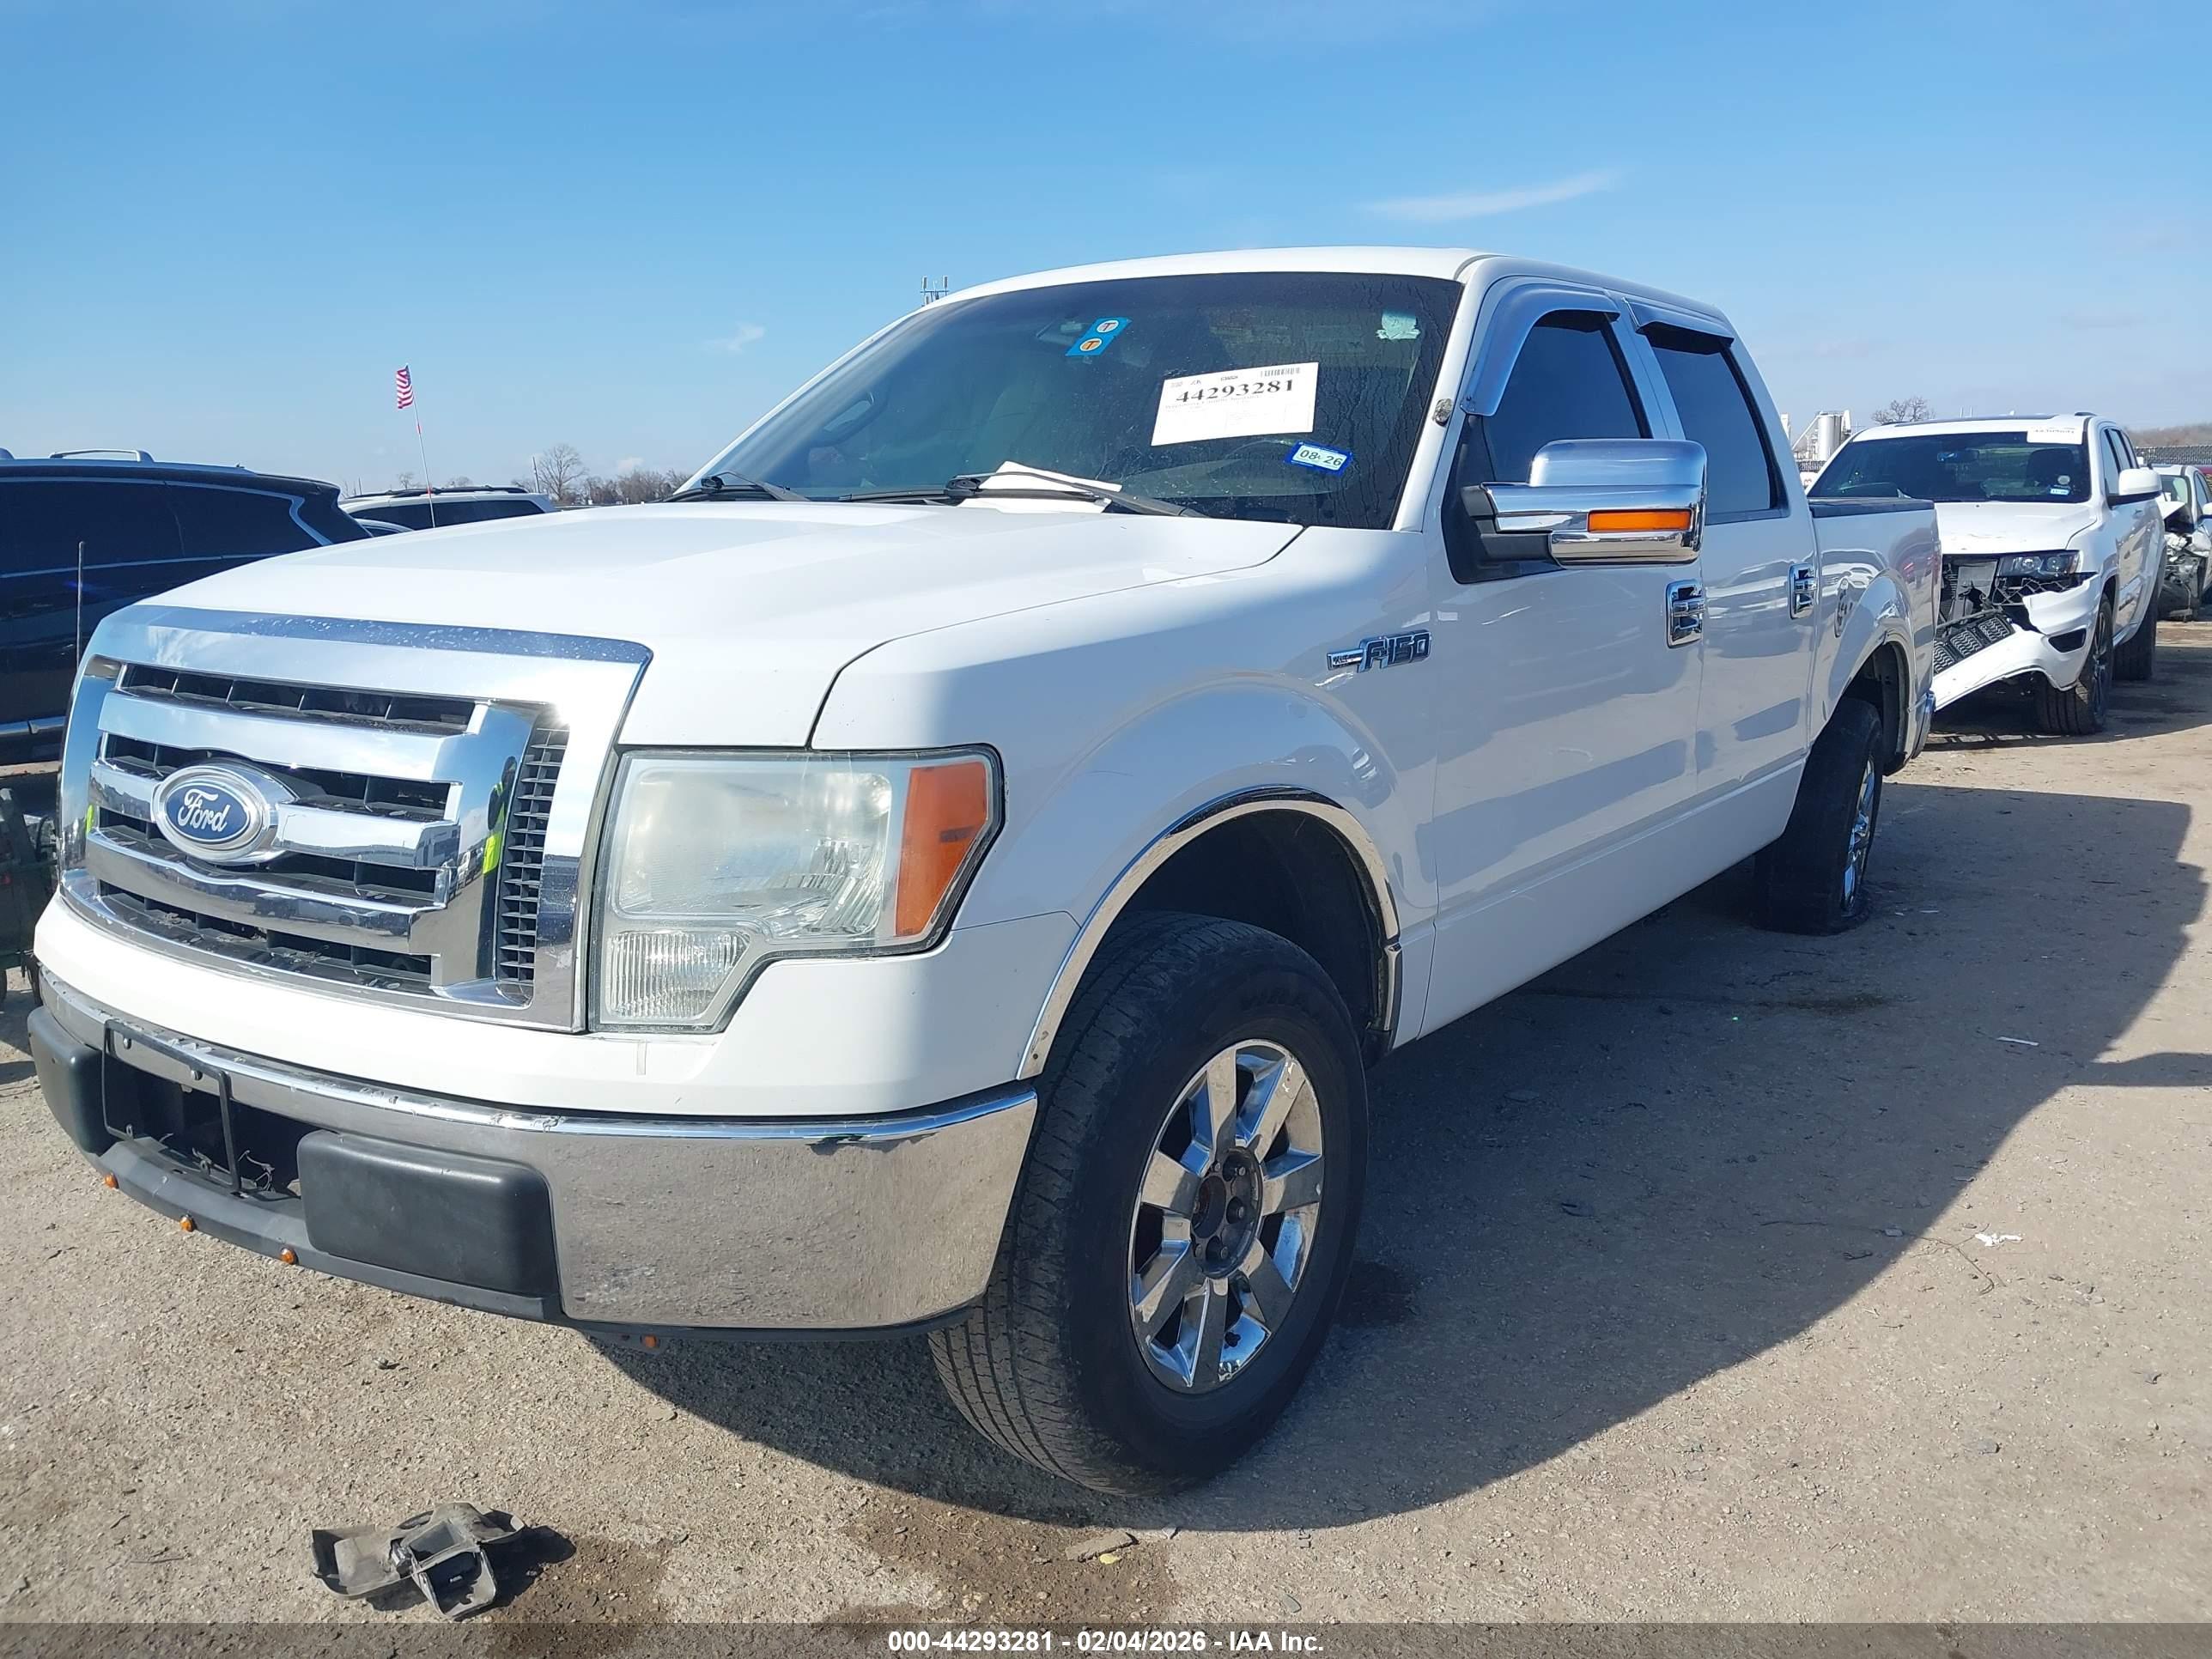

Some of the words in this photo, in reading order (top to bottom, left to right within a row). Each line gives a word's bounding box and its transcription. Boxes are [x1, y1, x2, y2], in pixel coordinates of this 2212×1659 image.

[1103, 322, 1117, 331] T
[1086, 340, 1100, 350] T
[1176, 379, 1293, 403] 44293281
[1300, 449, 1319, 460] 08
[1323, 455, 1343, 466] 26
[177, 788, 231, 832] Ford
